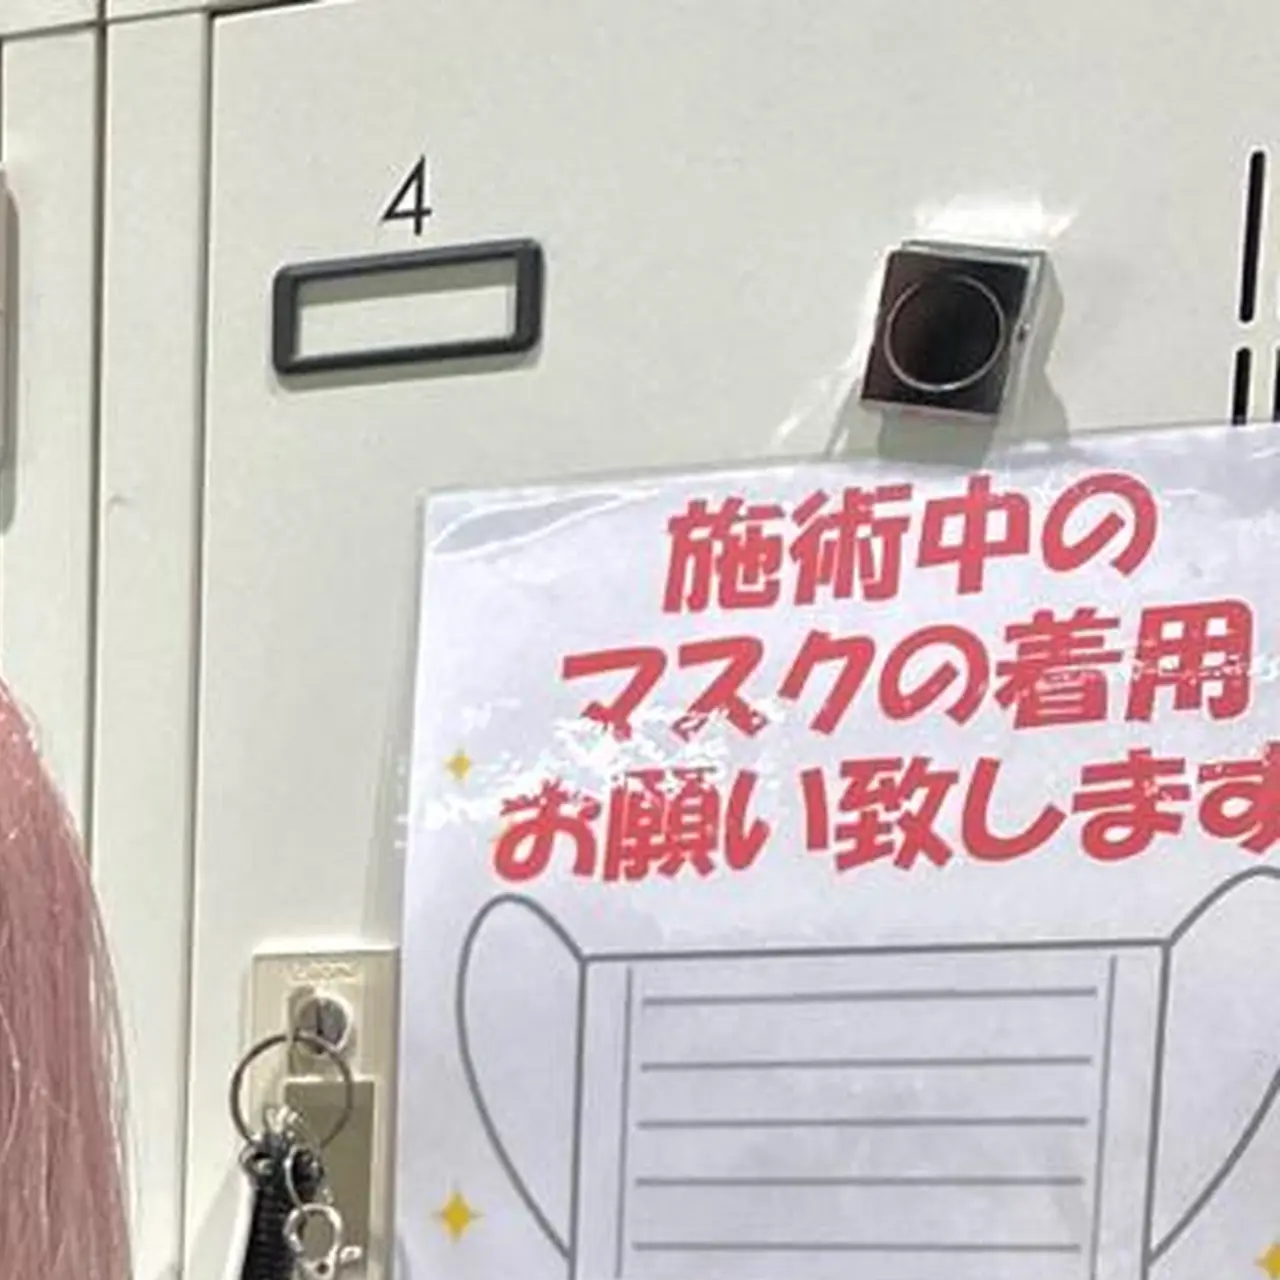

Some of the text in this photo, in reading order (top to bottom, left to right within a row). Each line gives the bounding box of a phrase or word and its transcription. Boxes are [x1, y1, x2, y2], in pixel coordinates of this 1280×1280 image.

[381, 155, 432, 237] 4
[662, 472, 1159, 614] 施術中の
[561, 598, 1256, 742] マスクの着用
[492, 738, 1280, 882] お願い致します
